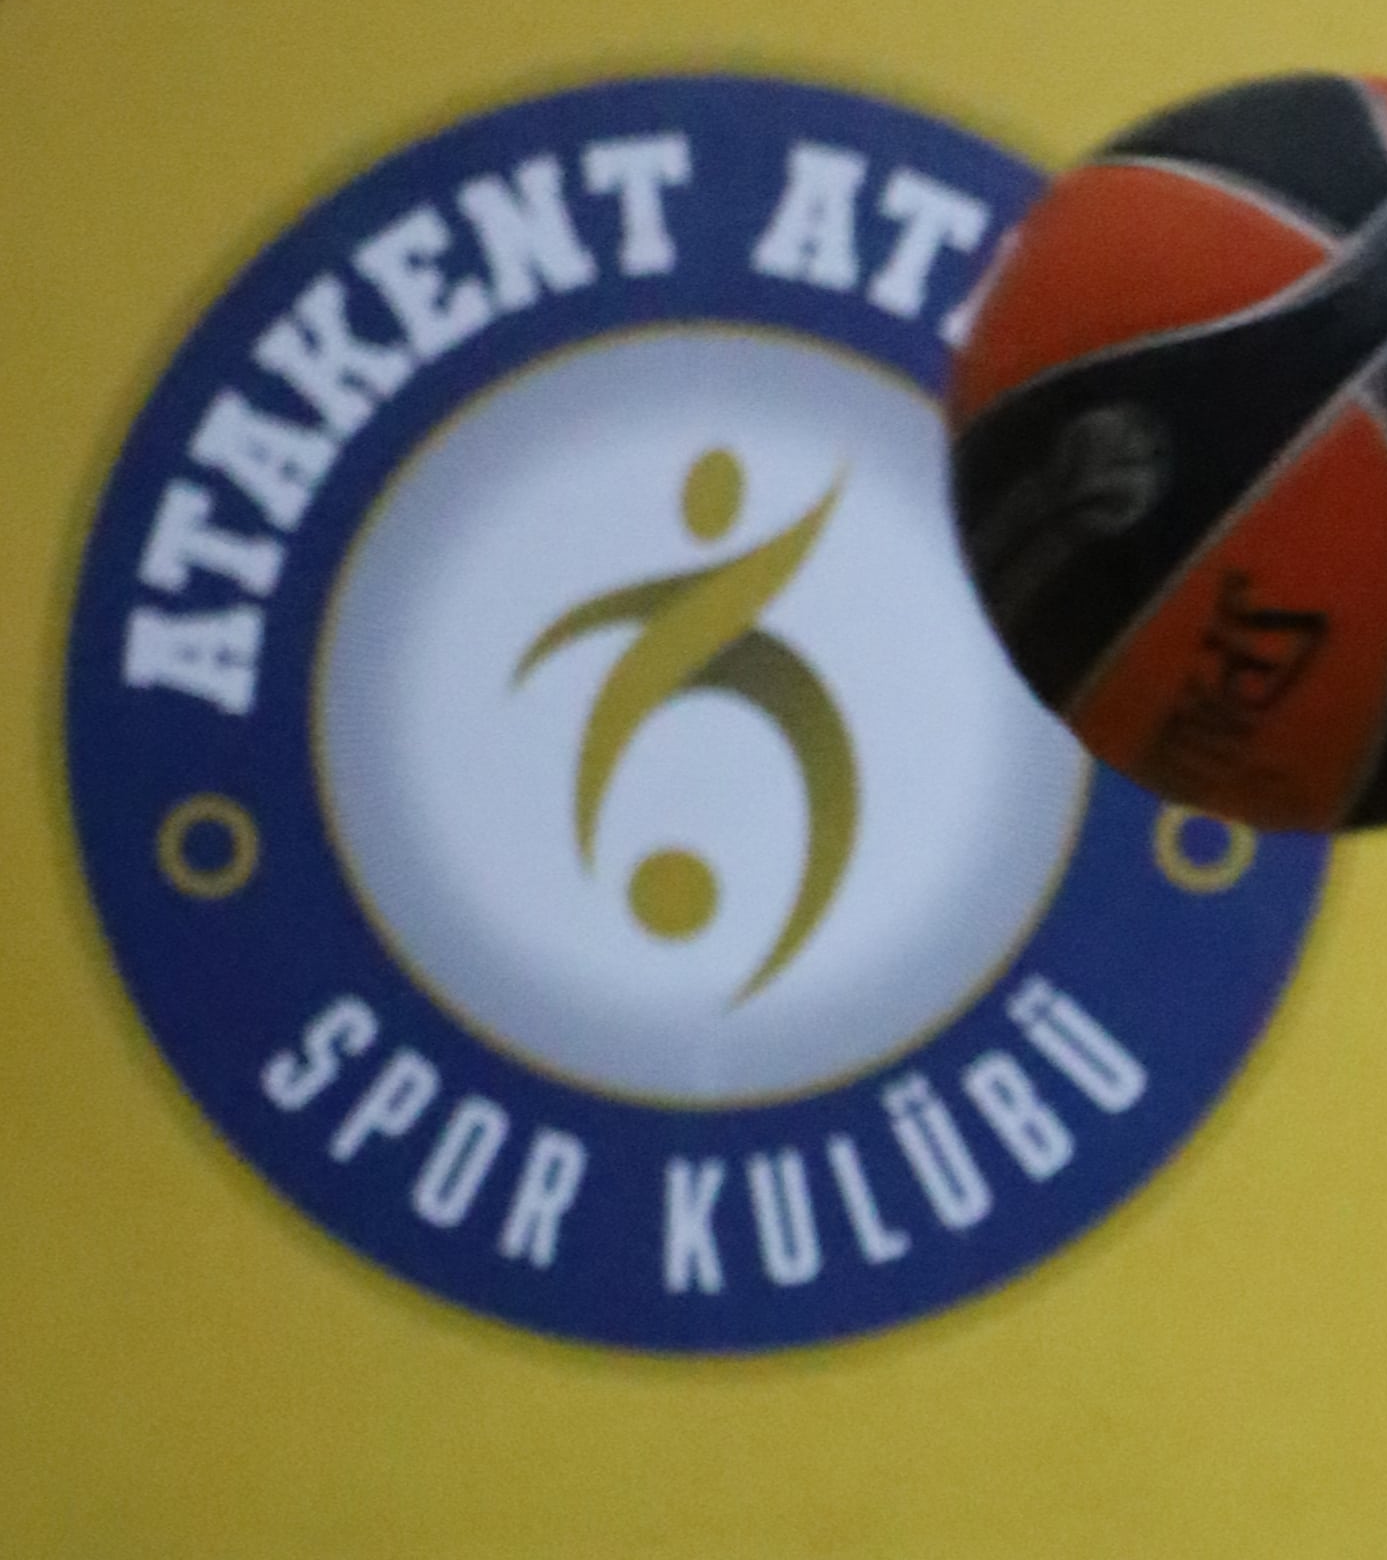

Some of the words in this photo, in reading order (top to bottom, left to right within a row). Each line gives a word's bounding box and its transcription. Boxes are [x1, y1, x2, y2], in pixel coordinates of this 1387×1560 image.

[120, 130, 694, 716] ATAKENT
[259, 994, 590, 1269] SPOR
[662, 973, 1150, 1295] KULÜBÜ
